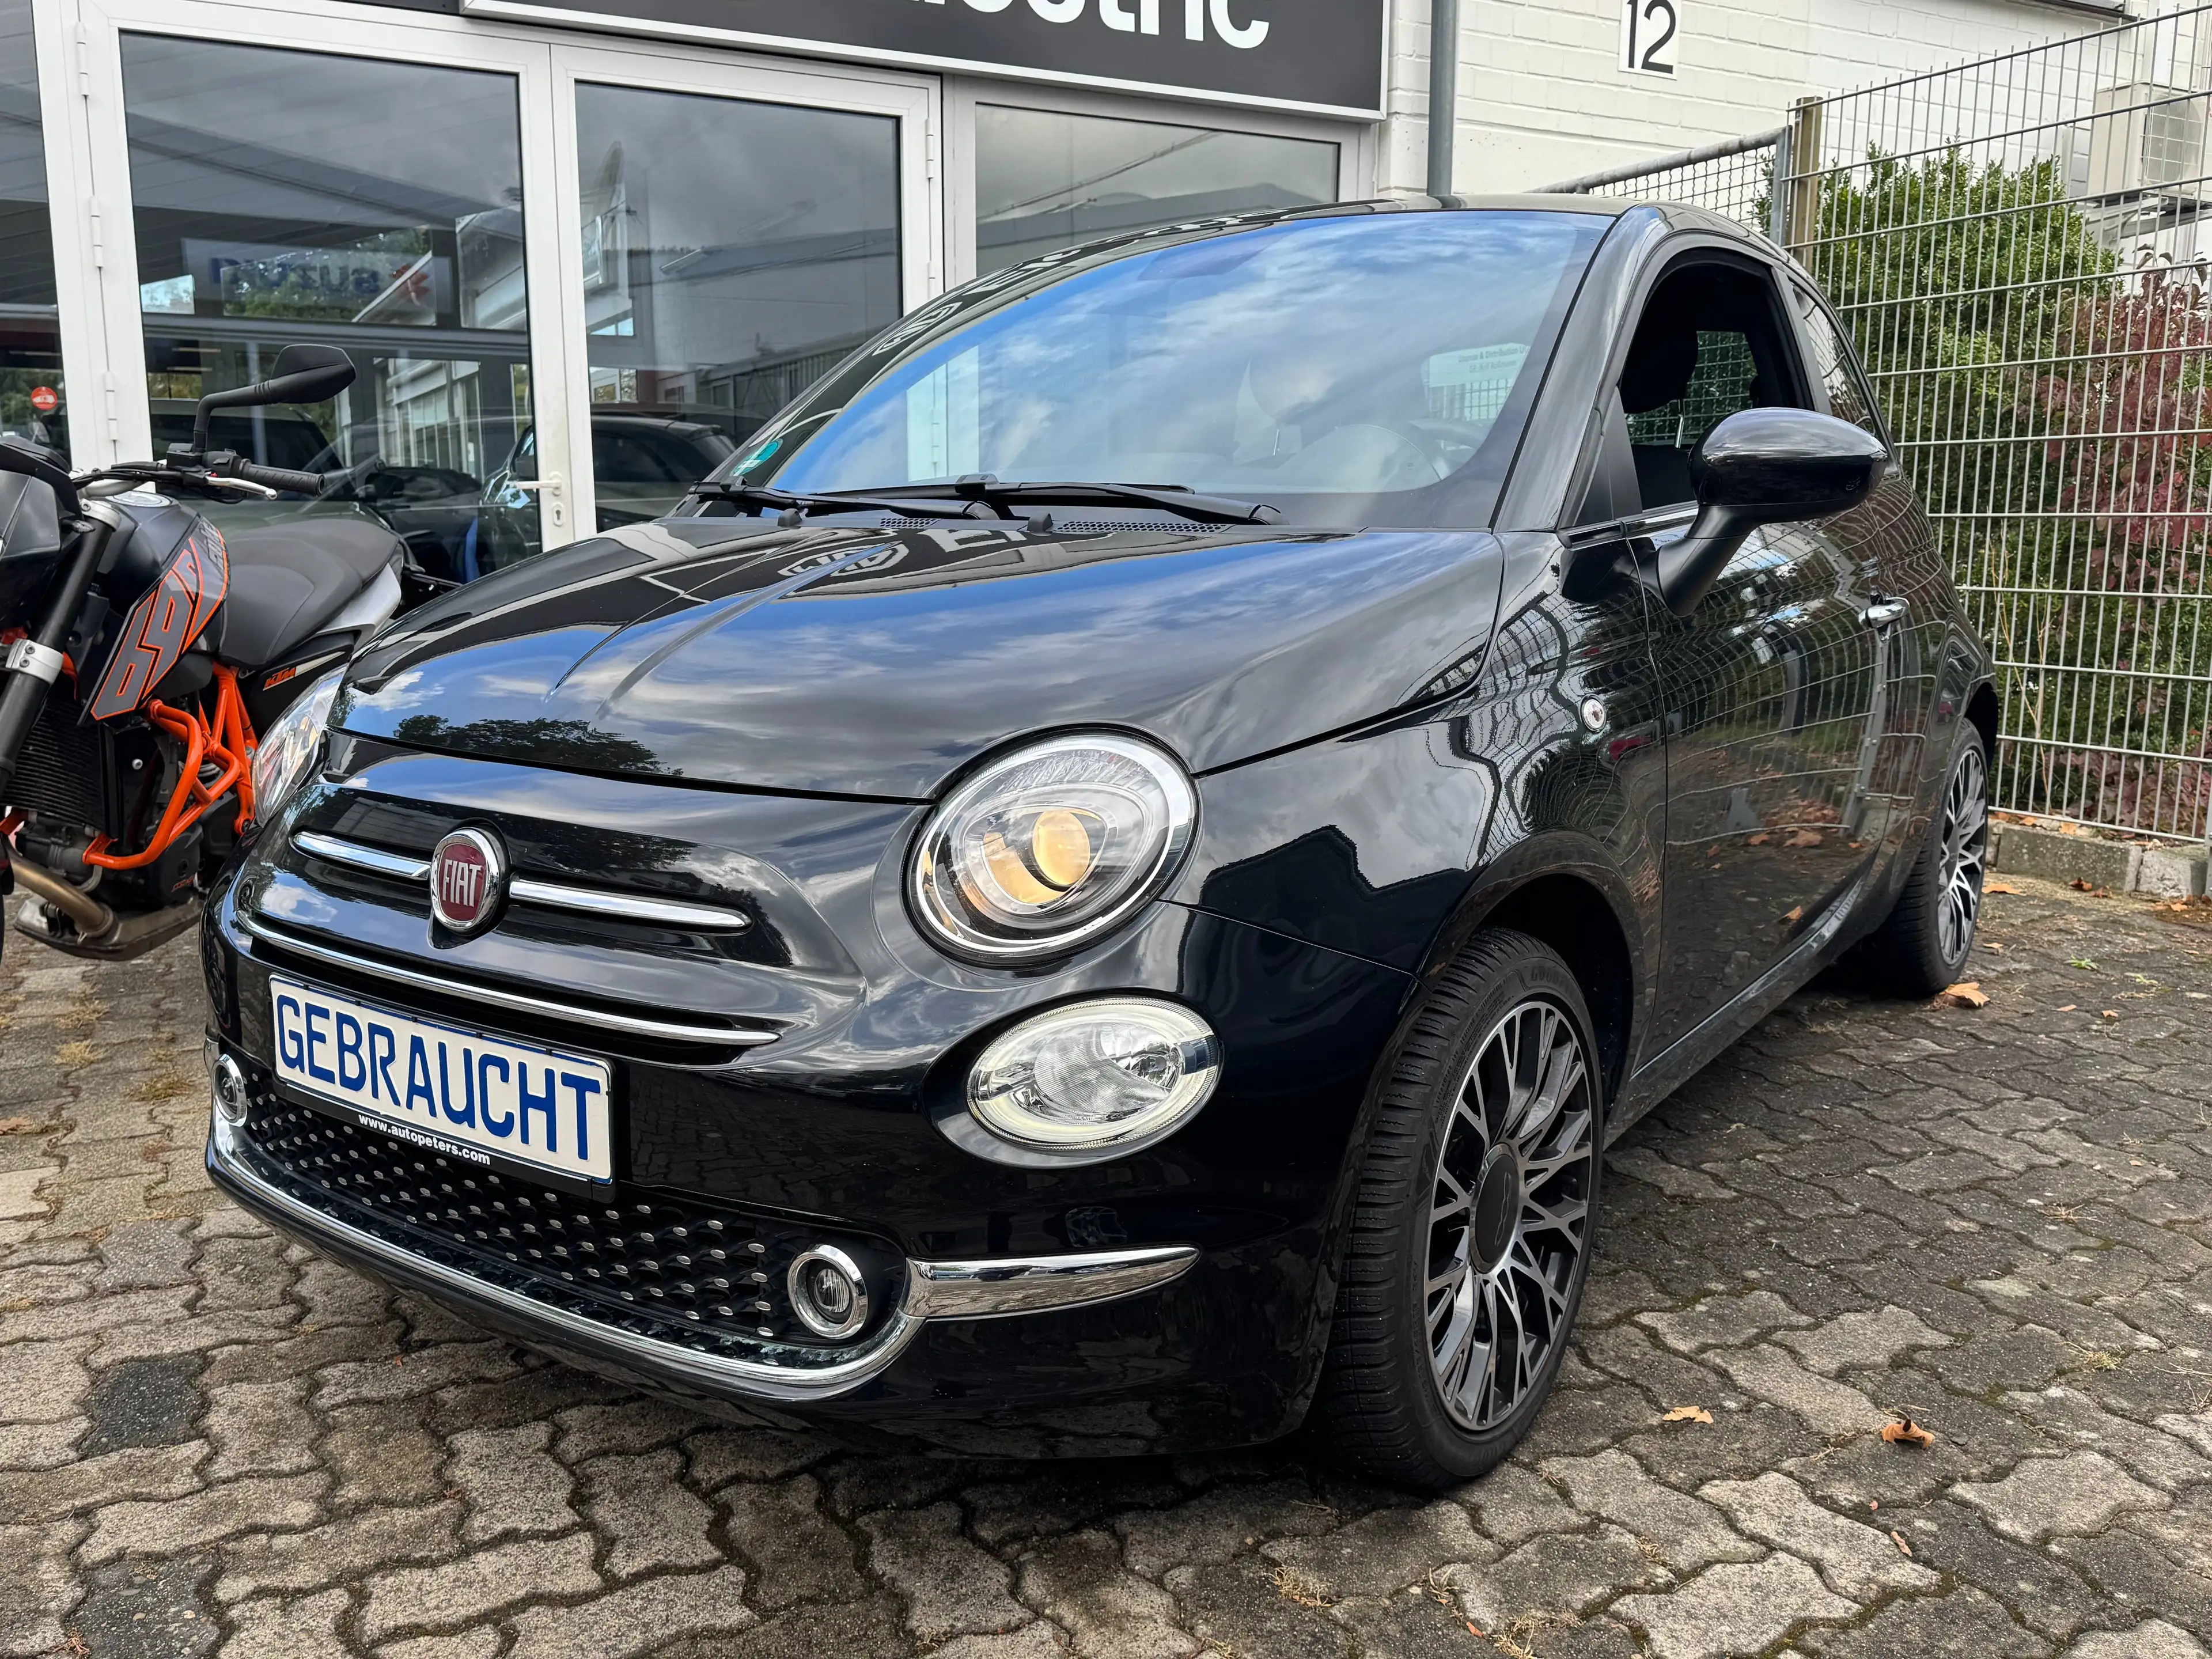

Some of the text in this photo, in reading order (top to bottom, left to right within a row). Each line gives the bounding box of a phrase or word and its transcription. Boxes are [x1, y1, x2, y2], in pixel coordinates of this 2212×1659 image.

[1626, 0, 1676, 74] 12
[264, 668, 296, 688] KTM
[442, 859, 482, 907] FIAT
[276, 994, 601, 1161] GEBRAUCHT
[358, 1114, 491, 1165] www.autopeters.com
